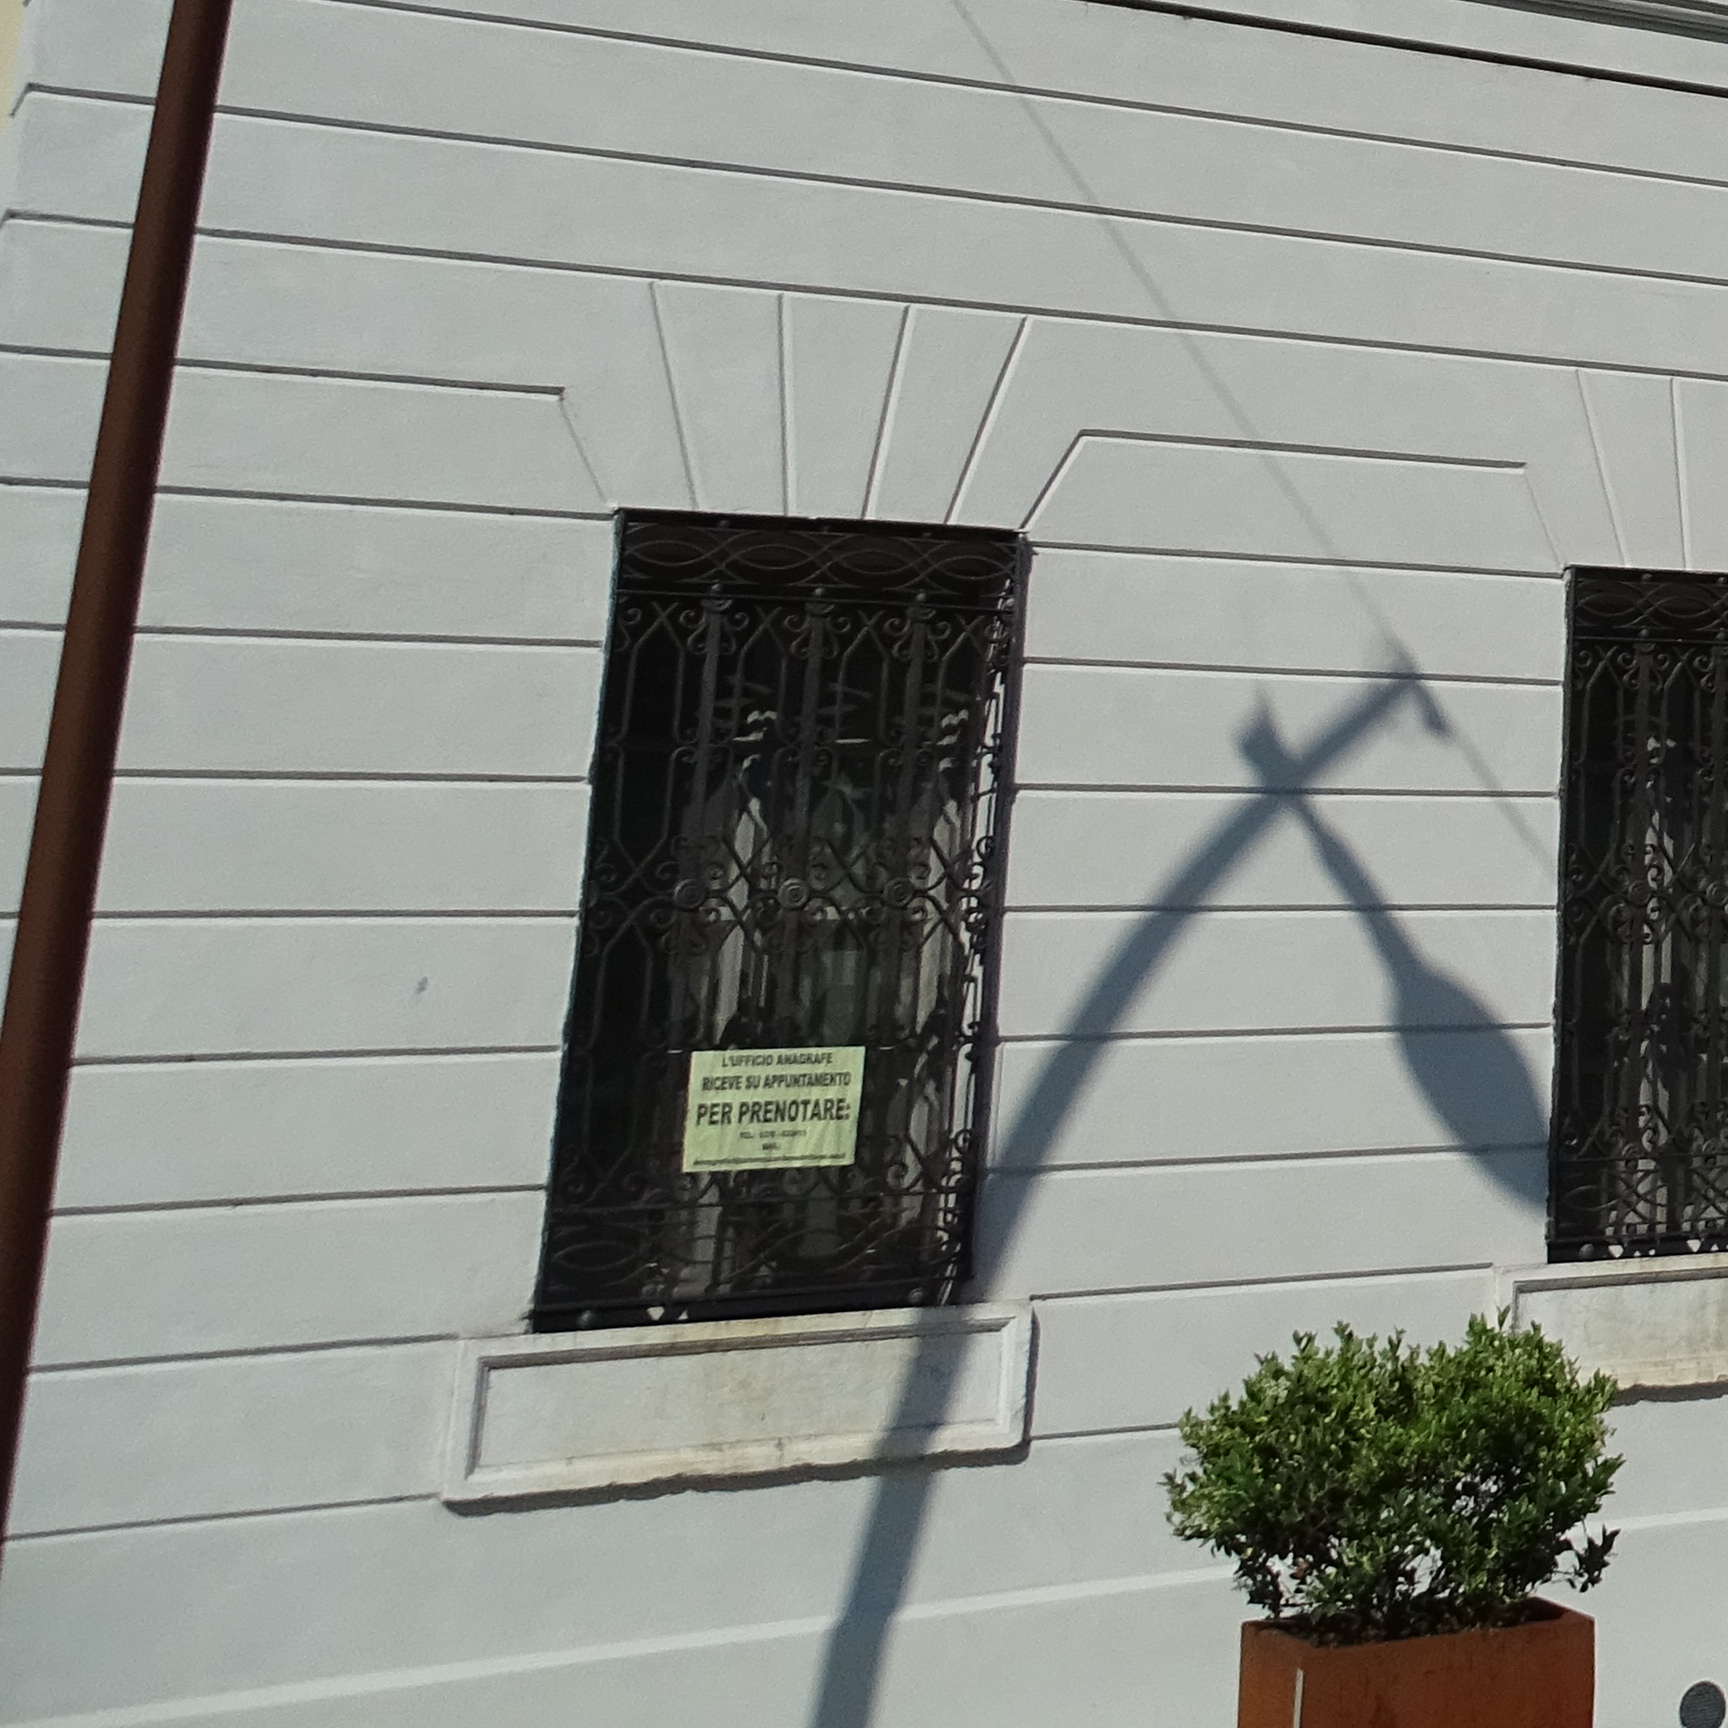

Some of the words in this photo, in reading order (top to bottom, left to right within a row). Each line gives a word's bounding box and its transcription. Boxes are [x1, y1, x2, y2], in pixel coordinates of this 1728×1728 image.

[721, 1054, 774, 1068] L'UFFICIO
[776, 1052, 833, 1067] ANAGRAFE
[702, 1075, 743, 1091] RICEVE
[745, 1074, 761, 1090] SU
[763, 1071, 852, 1090] APPUNTAMENTO
[696, 1102, 733, 1126] PER
[738, 1098, 851, 1124] PRENOTARE:
